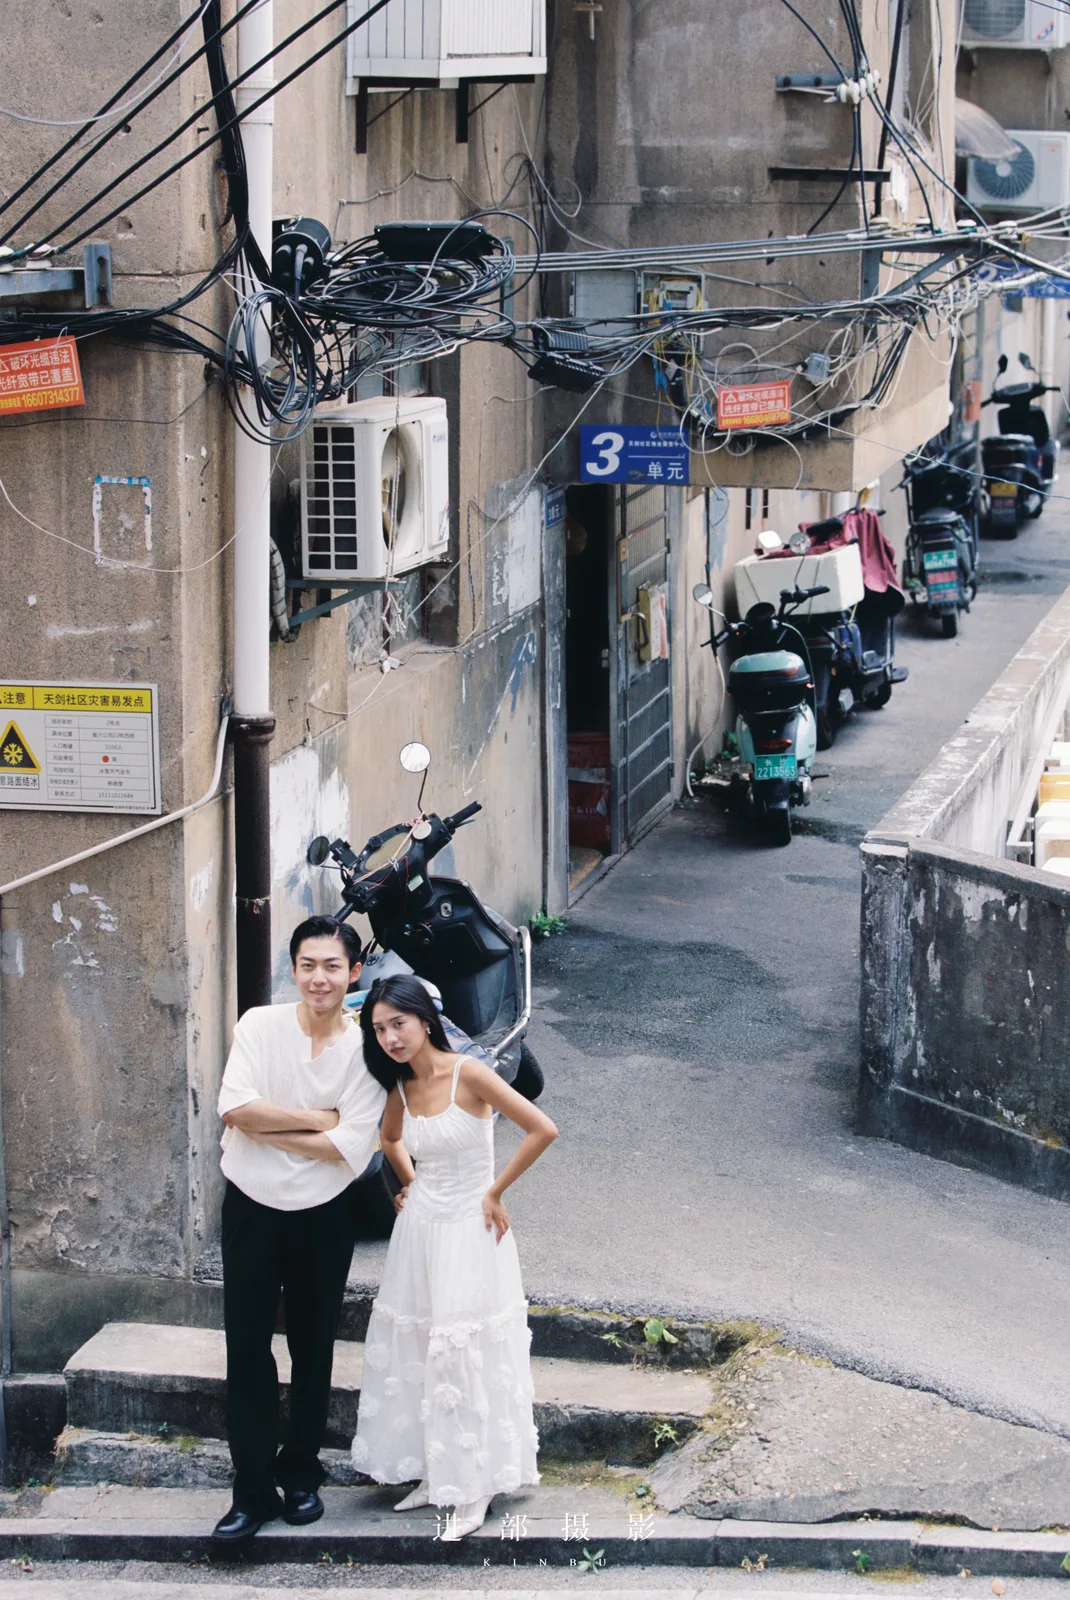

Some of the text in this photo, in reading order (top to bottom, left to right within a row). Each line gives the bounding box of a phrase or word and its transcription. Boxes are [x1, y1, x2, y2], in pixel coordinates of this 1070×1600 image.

[21, 387, 80, 408] 16607314377
[585, 431, 625, 476] 3
[647, 461, 684, 480] 单元
[3, 691, 145, 707] 注意 天剑社区灾害易发点
[757, 765, 796, 778] 2213563
